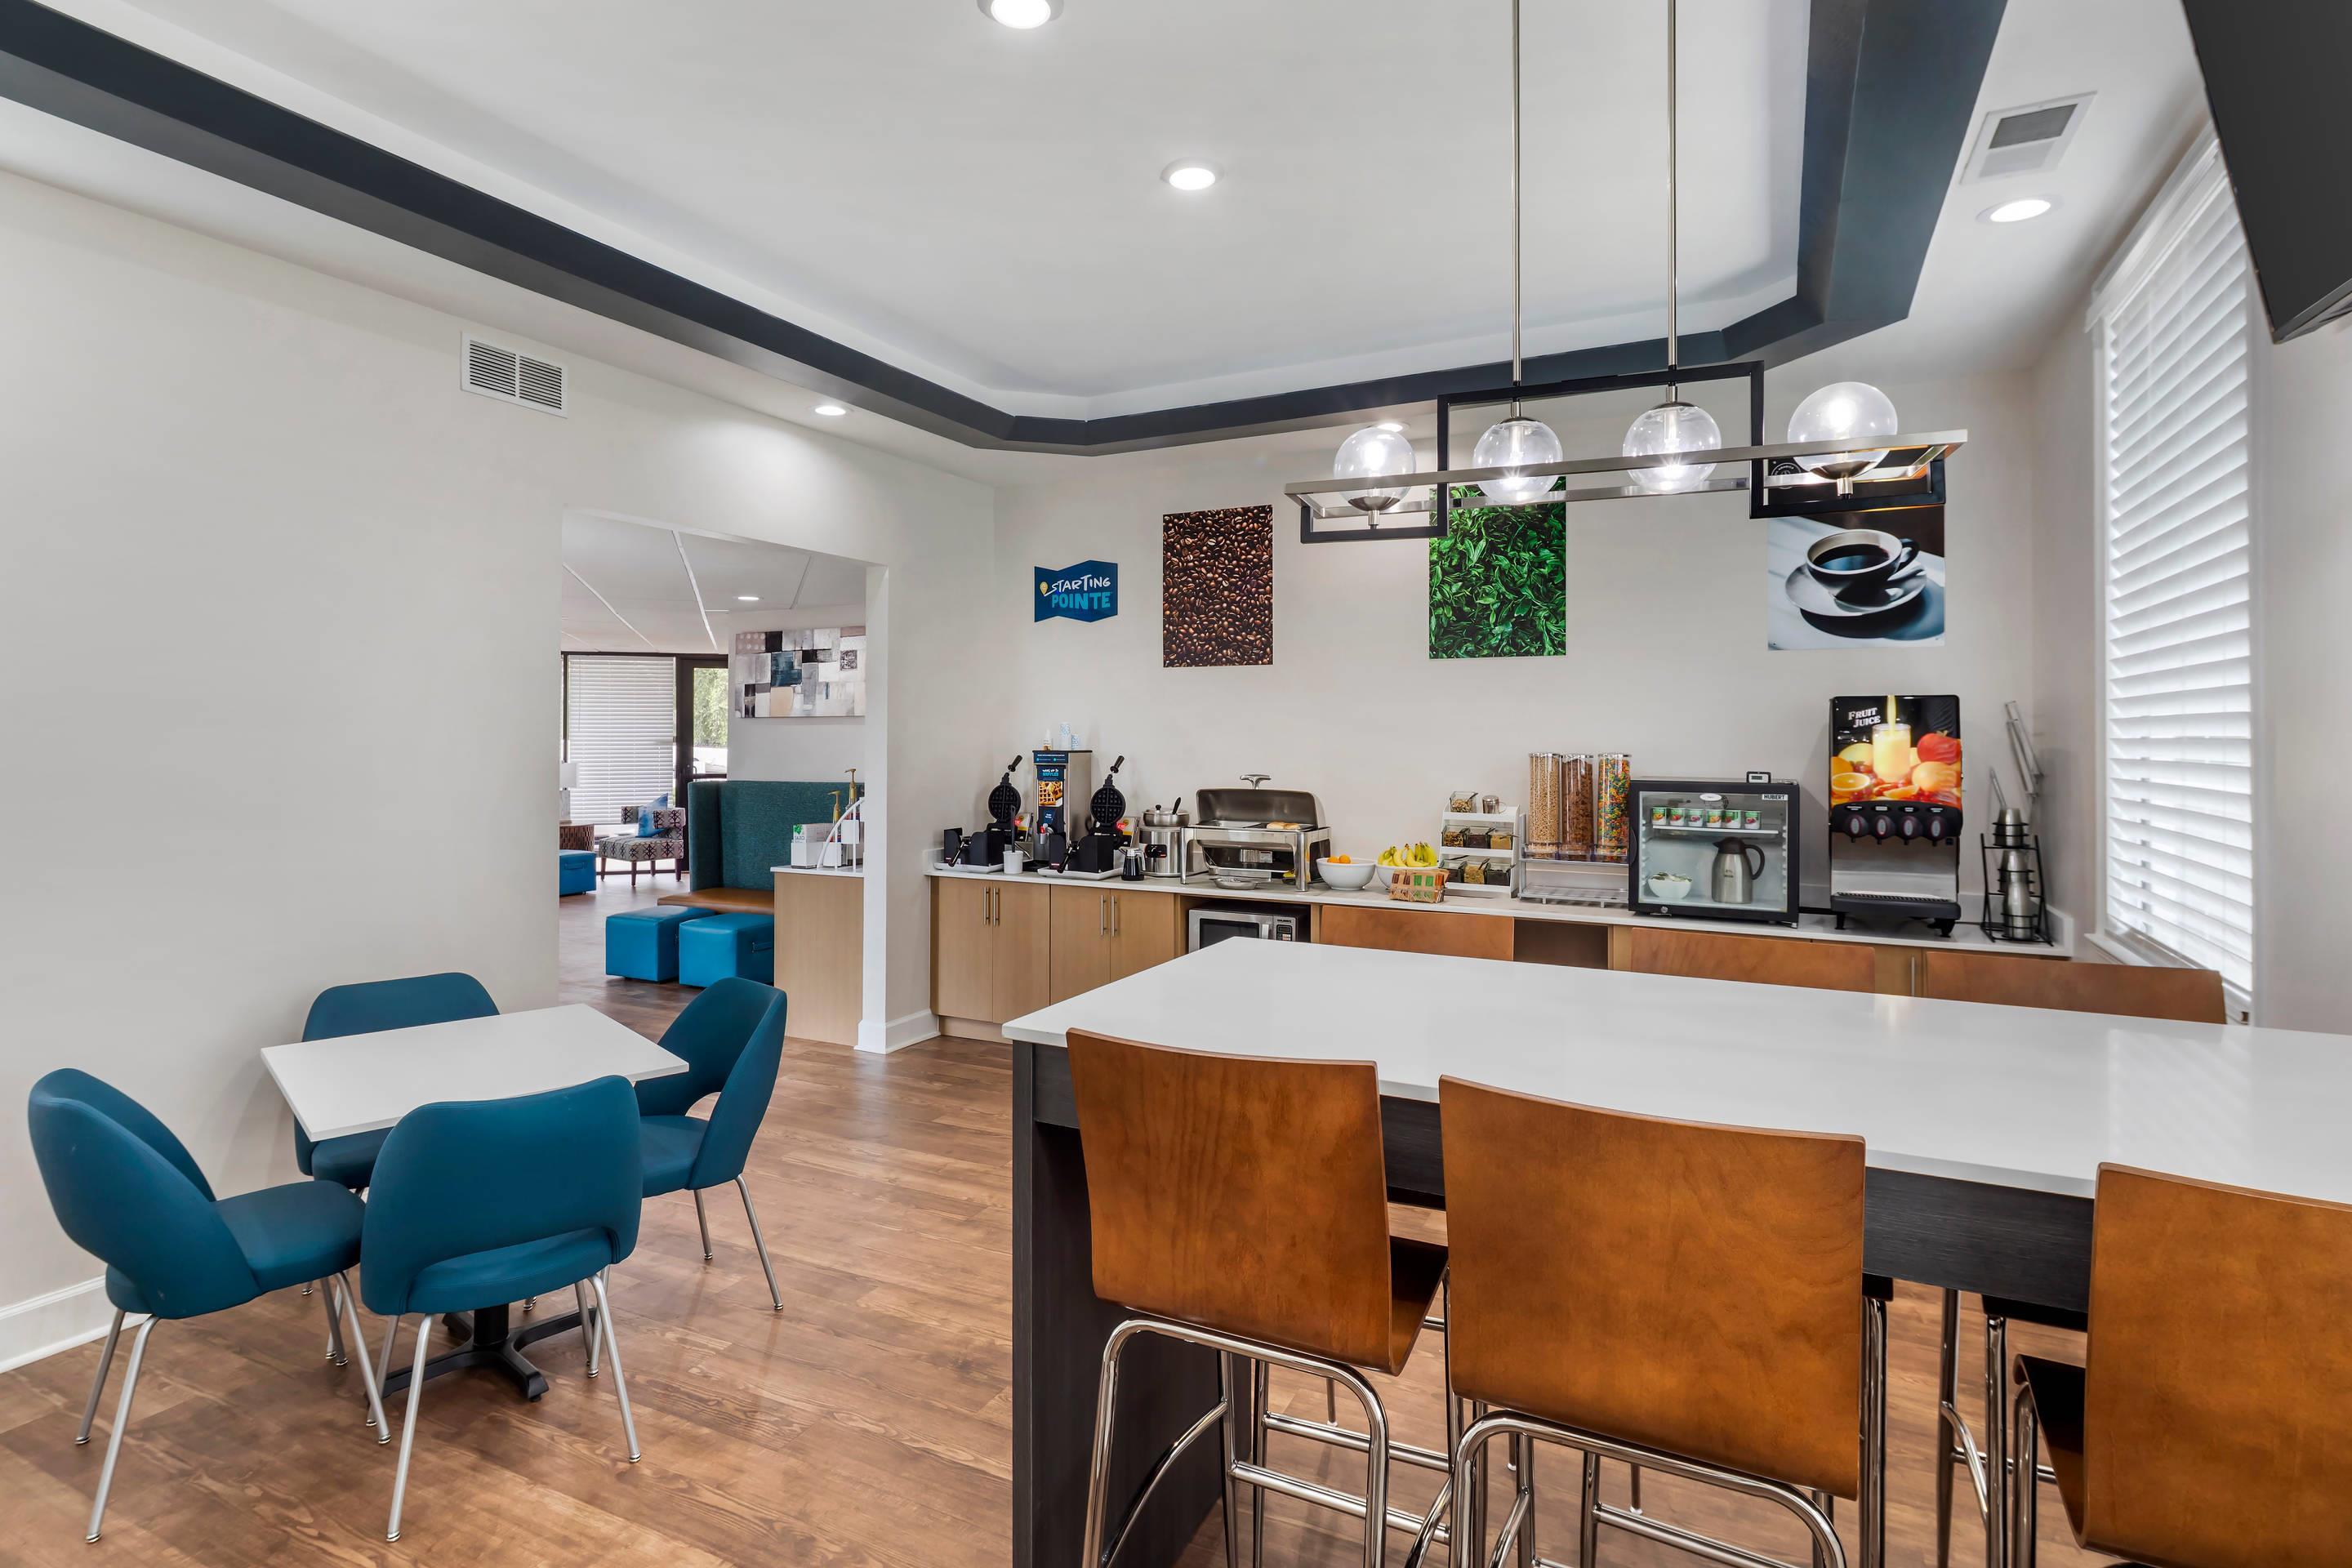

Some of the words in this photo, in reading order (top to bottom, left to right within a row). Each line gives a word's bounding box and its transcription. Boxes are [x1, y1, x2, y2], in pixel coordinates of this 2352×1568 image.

[1045, 574, 1111, 596] STARTING
[1052, 592, 1111, 609] POINTE
[1848, 707, 1878, 720] FRUIT
[1853, 715, 1881, 728] JUICE
